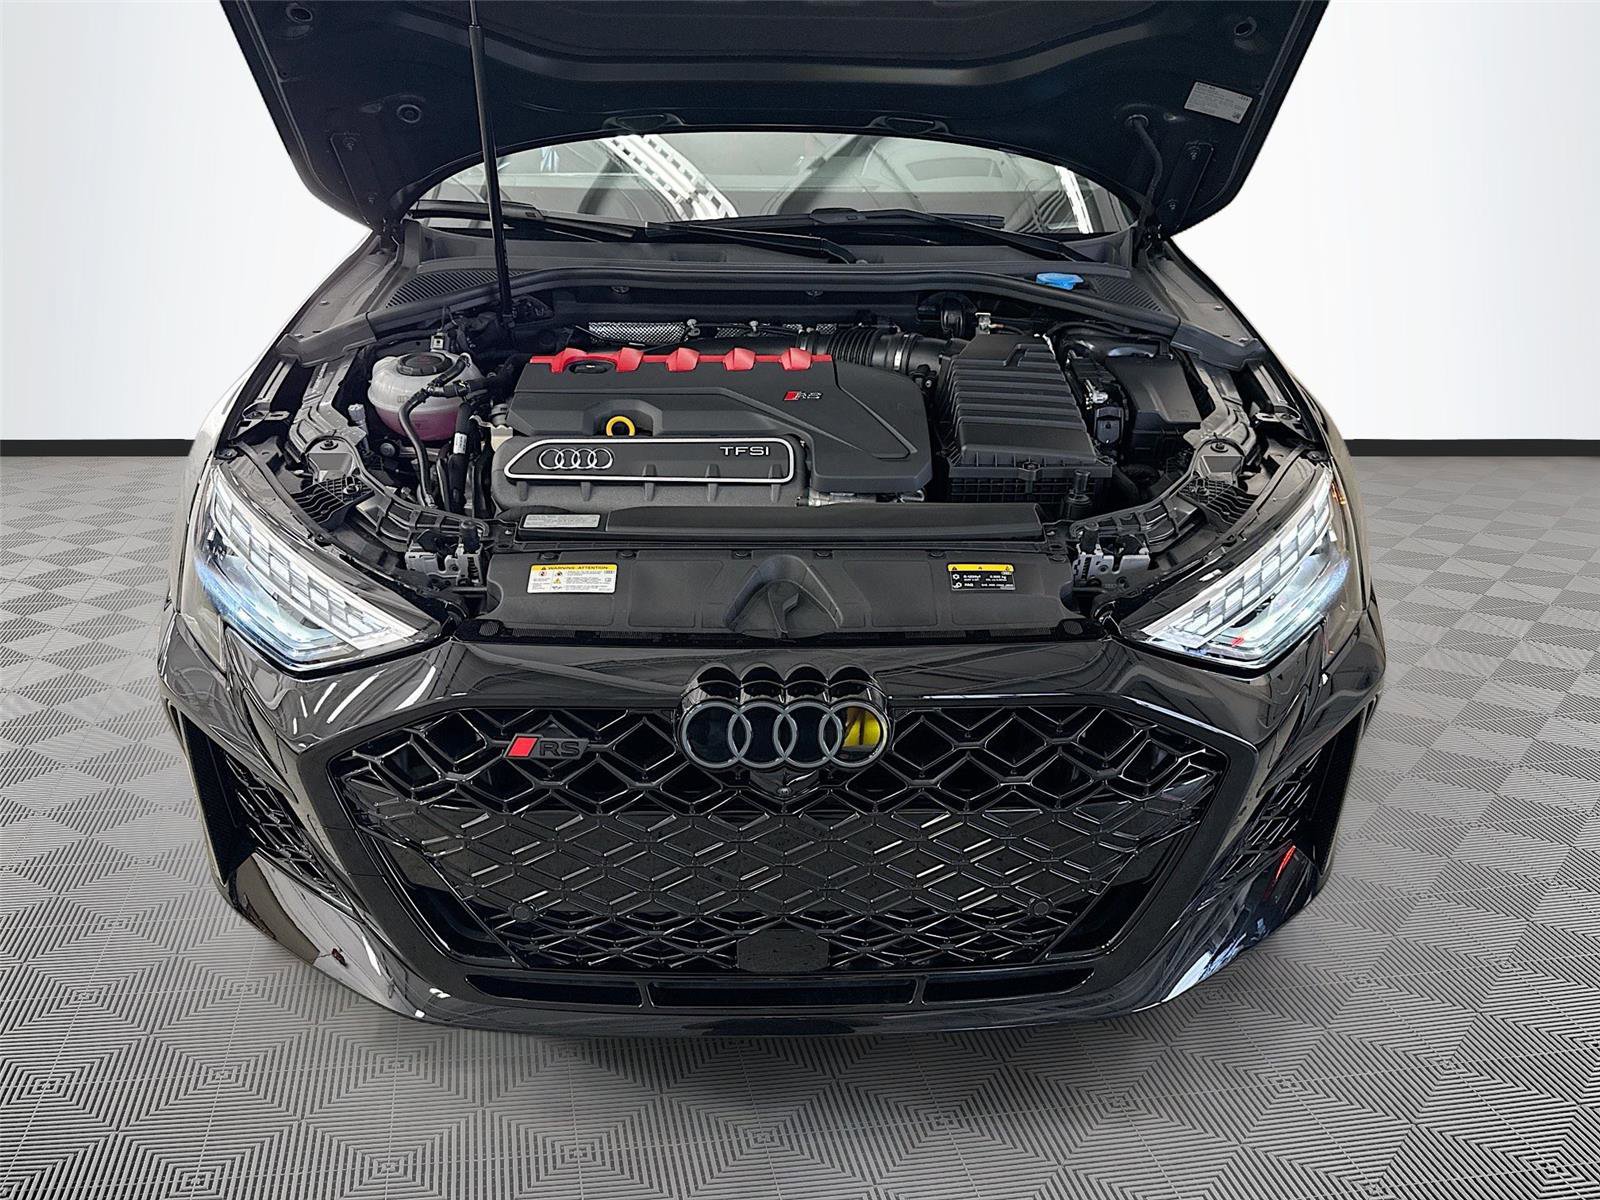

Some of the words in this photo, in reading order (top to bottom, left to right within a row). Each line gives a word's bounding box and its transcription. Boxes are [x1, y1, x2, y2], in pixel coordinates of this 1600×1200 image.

[794, 391, 822, 401] RS
[719, 446, 769, 456] TFSI
[540, 740, 580, 757] RS
